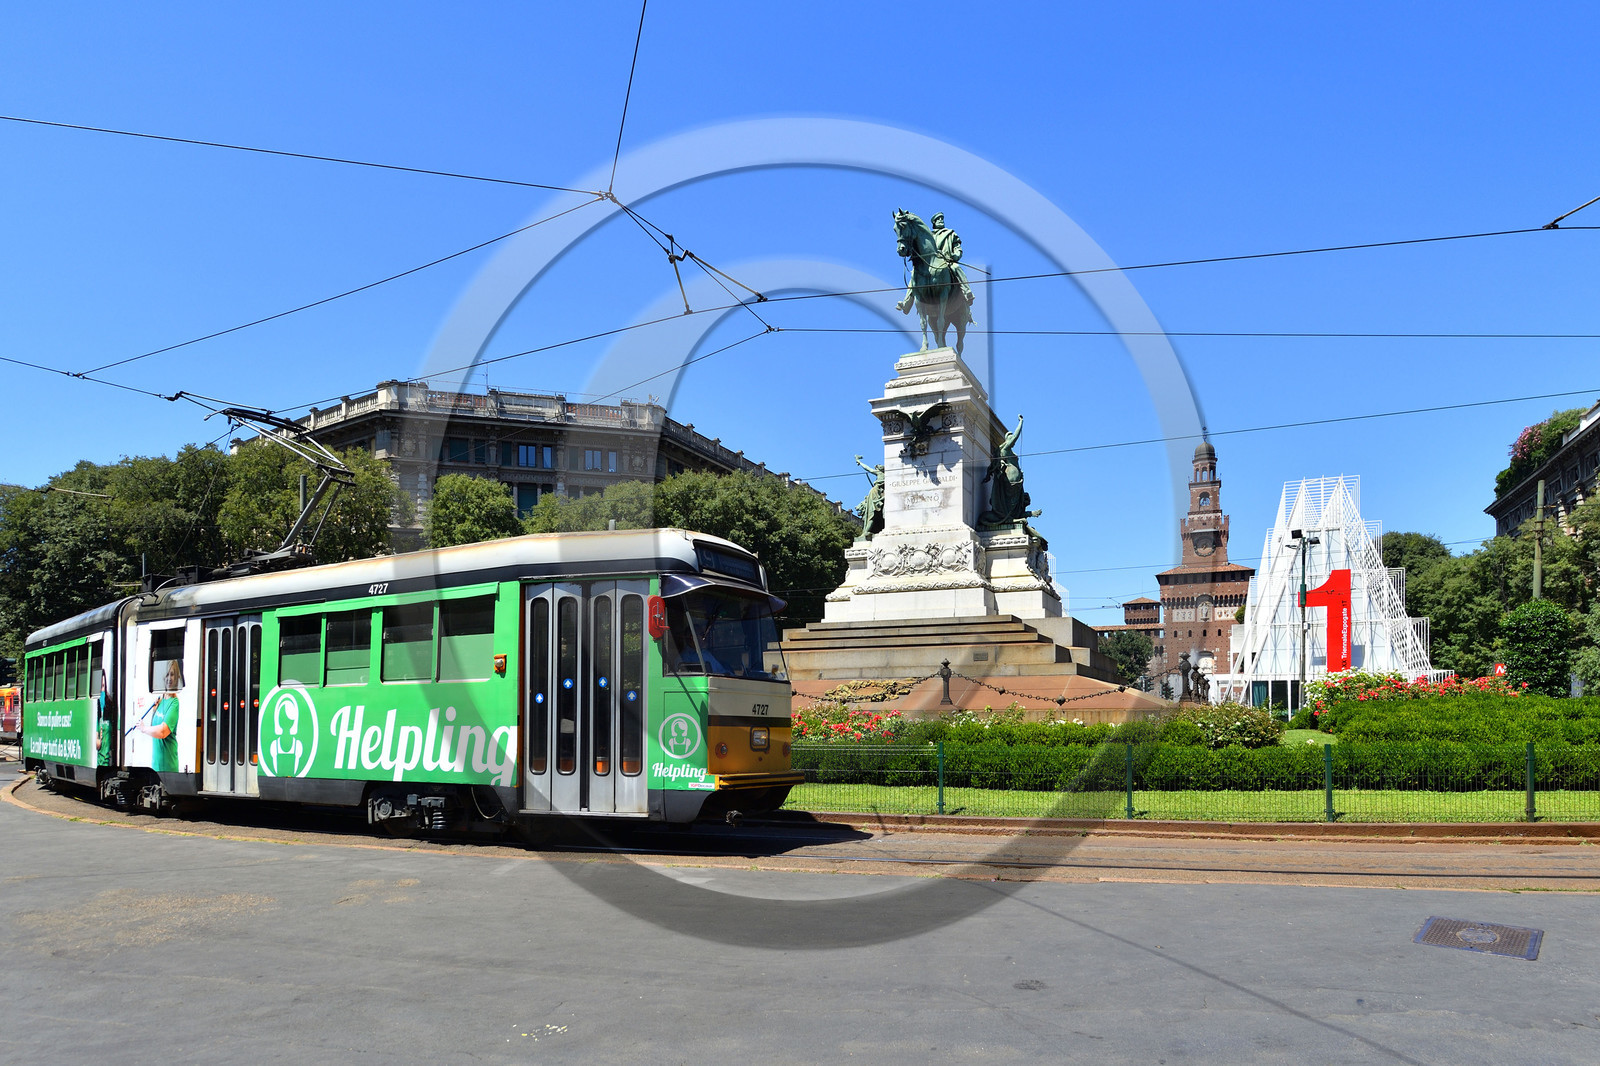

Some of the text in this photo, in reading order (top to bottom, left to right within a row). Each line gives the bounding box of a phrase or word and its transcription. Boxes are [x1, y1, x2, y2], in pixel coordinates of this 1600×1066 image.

[368, 583, 389, 595] 4727
[1298, 569, 1351, 672] 1
[751, 704, 769, 716] 4727
[330, 705, 518, 787] Helpling
[652, 763, 707, 782] Helpling
